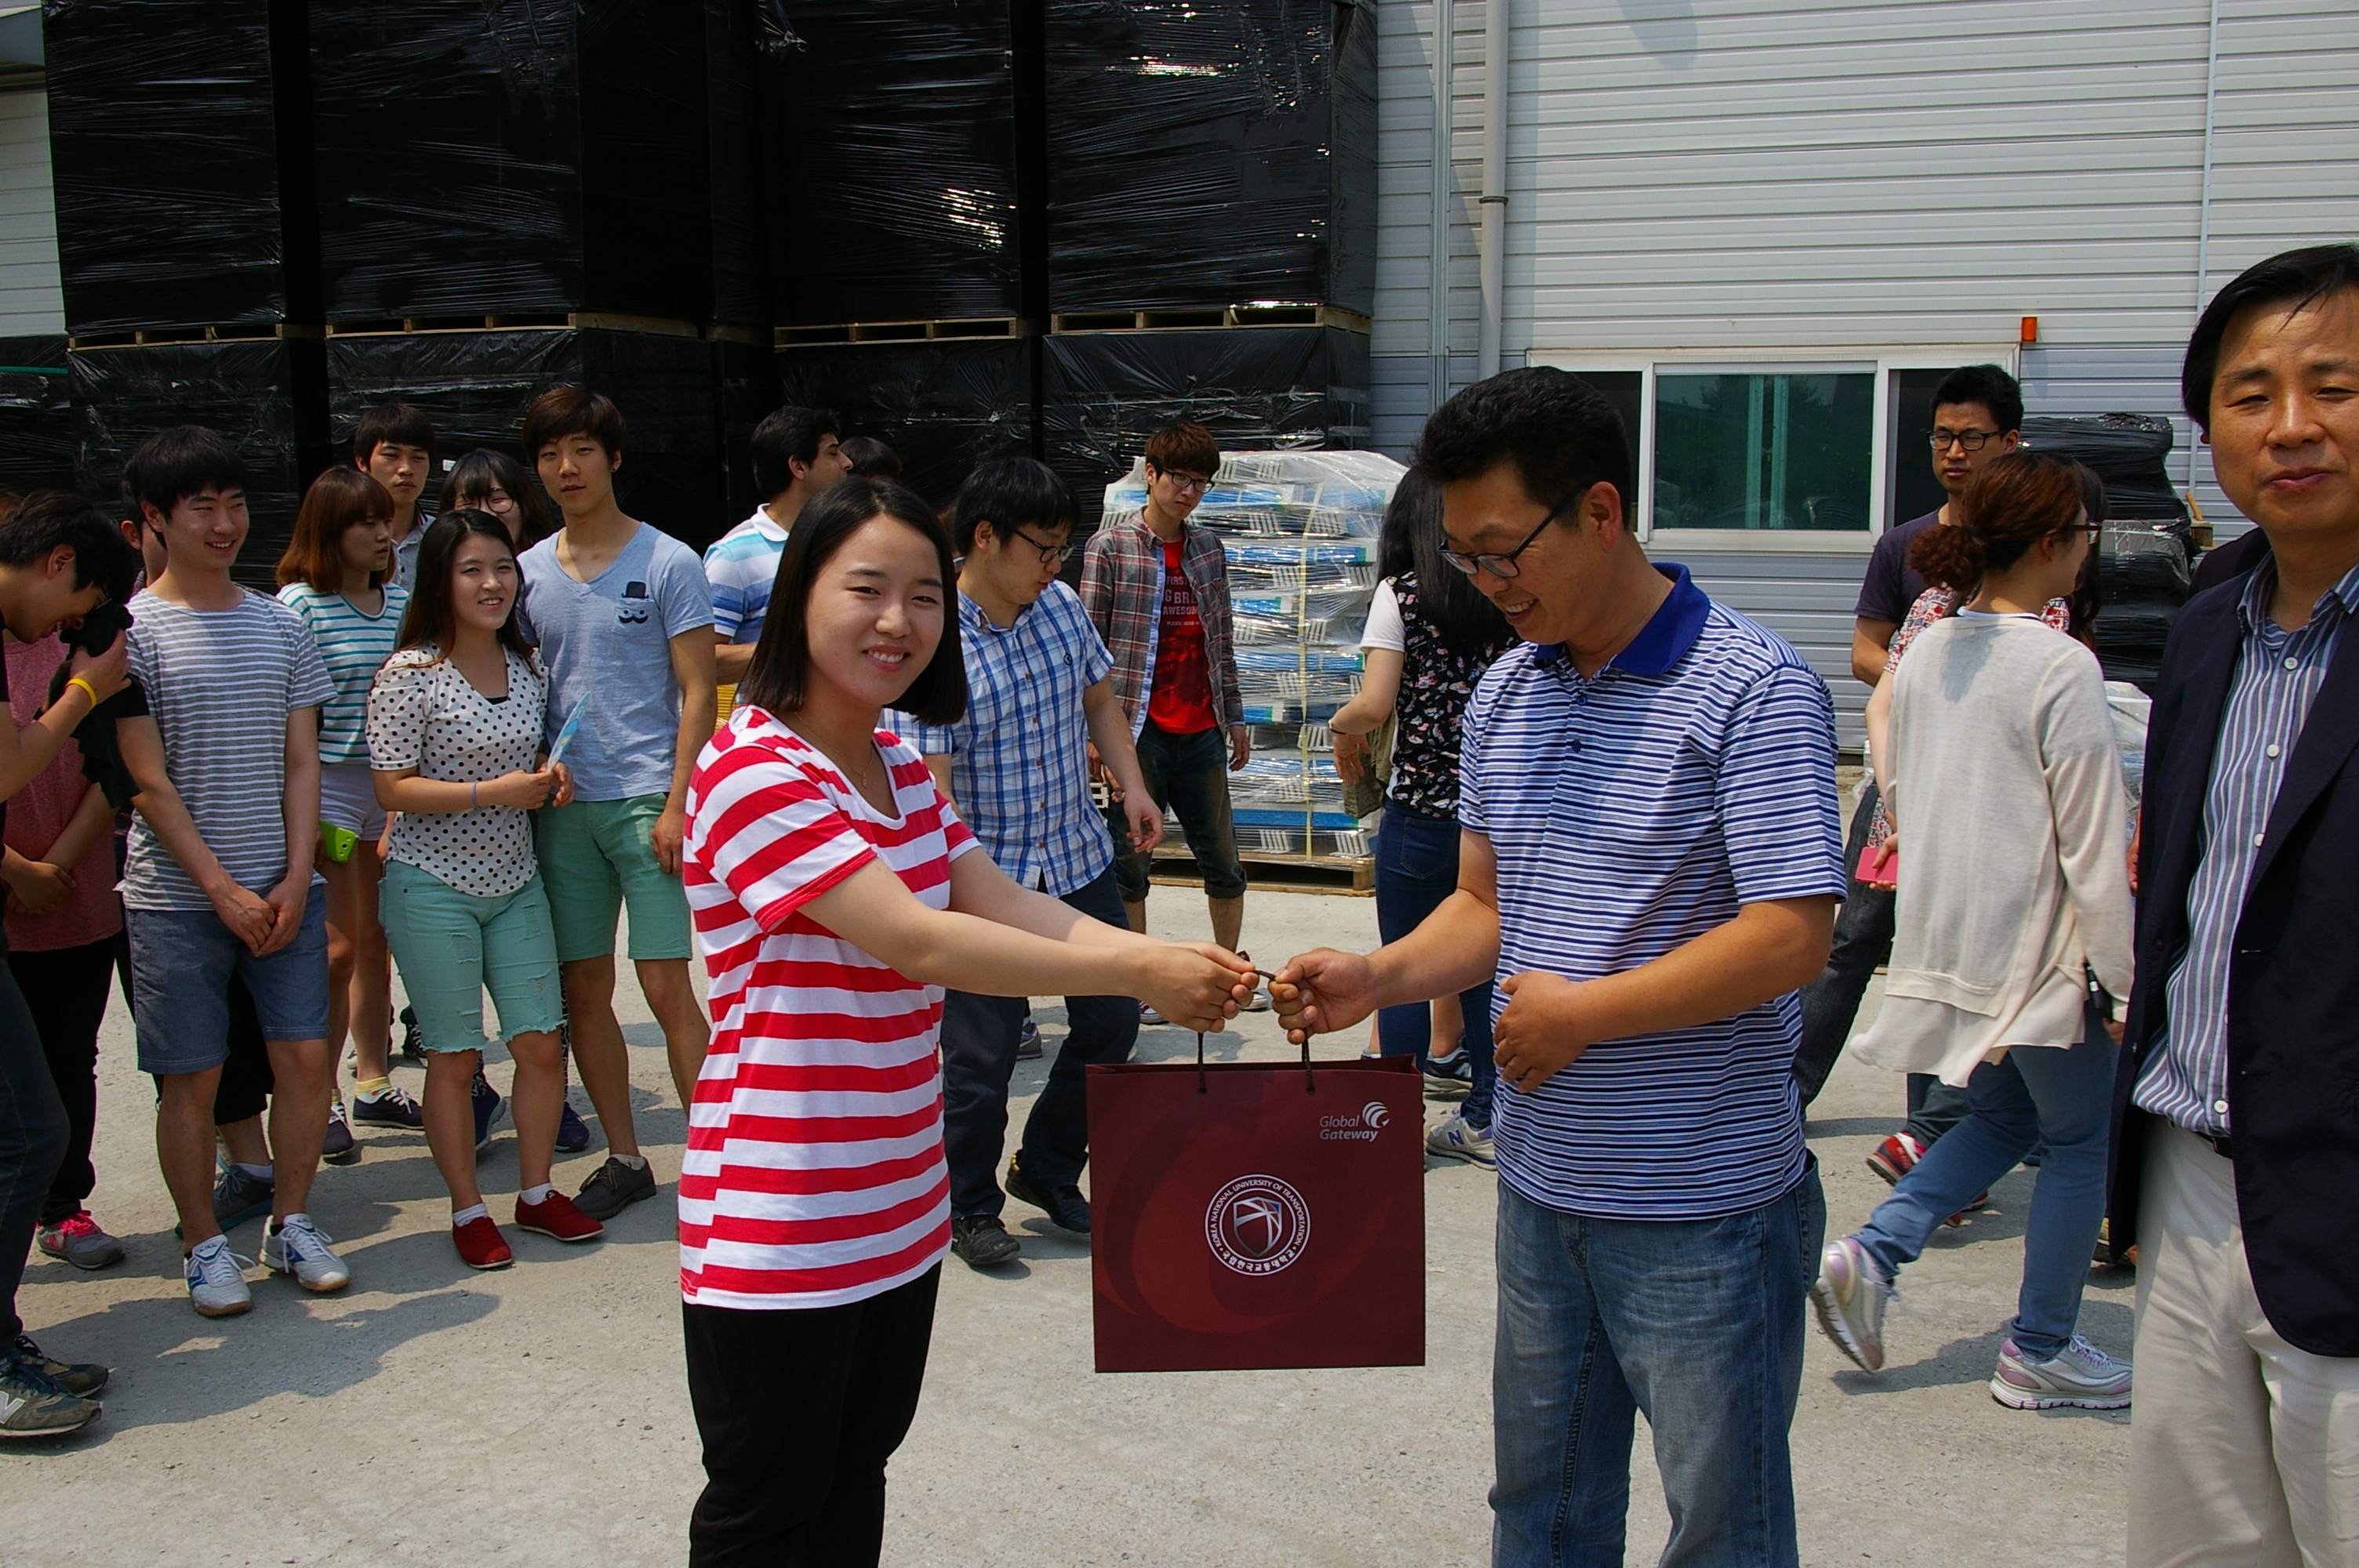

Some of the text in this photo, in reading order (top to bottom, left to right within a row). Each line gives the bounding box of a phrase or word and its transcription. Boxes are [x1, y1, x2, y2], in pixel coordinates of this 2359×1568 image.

[1166, 575, 1187, 586] FIRST
[1319, 1115, 1360, 1127] Global
[1320, 1129, 1378, 1142] Gateway
[1232, 1179, 1273, 1192] UNIVERSITY
[1210, 1189, 1234, 1222] NATIONAL
[1281, 1187, 1306, 1246] TRANSPORTATION
[1210, 1223, 1223, 1247] KOREA
